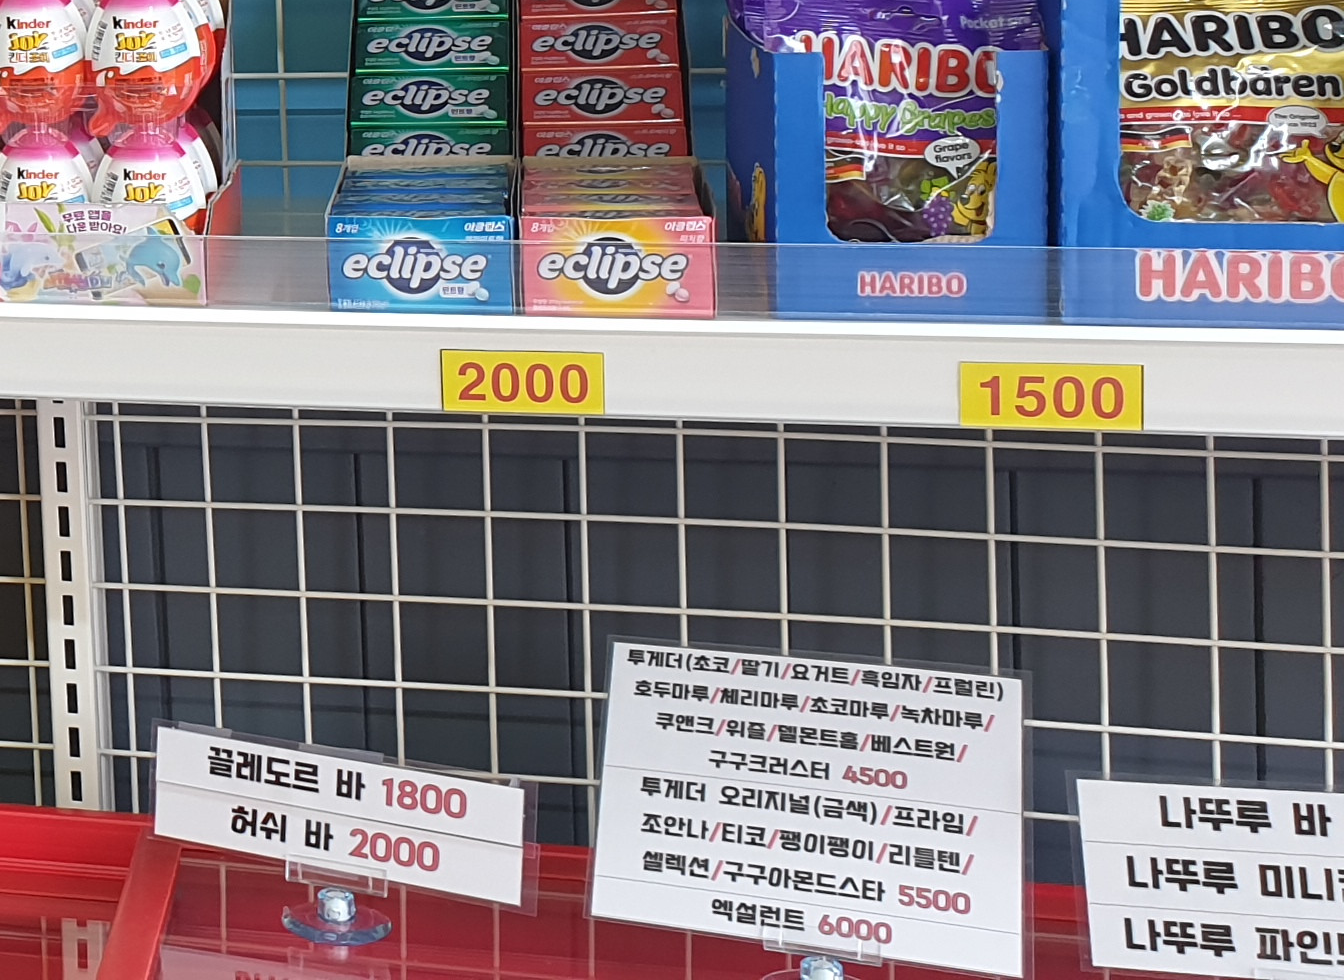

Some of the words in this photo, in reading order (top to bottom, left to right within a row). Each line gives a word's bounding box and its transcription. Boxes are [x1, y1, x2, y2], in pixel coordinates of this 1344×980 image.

[366, 27, 493, 58] eclipse
[532, 23, 661, 56] eclipse
[1120, 5, 1344, 58] HARIBO
[362, 79, 490, 110] eclipse
[534, 76, 667, 110] eclipse
[933, 142, 969, 155] Grape
[934, 152, 973, 164] flavors
[342, 247, 489, 289] eclipse
[537, 247, 689, 289] eclipse
[859, 272, 967, 297] HARIBO
[458, 361, 589, 404] 2000
[979, 375, 1125, 420] 1500
[208, 746, 321, 794] 끌레도르
[337, 768, 366, 801] 바
[381, 777, 468, 819] 1800
[640, 775, 707, 803] 투게더
[708, 749, 831, 782] 구구크러스터
[841, 765, 909, 790] 4500
[1159, 795, 1272, 834] 나뚜루
[1292, 802, 1332, 837] 바
[230, 805, 287, 843] 허쉬
[305, 818, 334, 852] 바
[348, 828, 440, 872] 2000
[1126, 855, 1239, 894] 나뚜루
[1258, 864, 1344, 902] 미니
[711, 897, 806, 931] 엑설런트
[817, 914, 893, 945] 6000
[897, 884, 972, 916] 5500
[1124, 917, 1236, 958] 나뚜루
[1255, 926, 1344, 966] 파인
